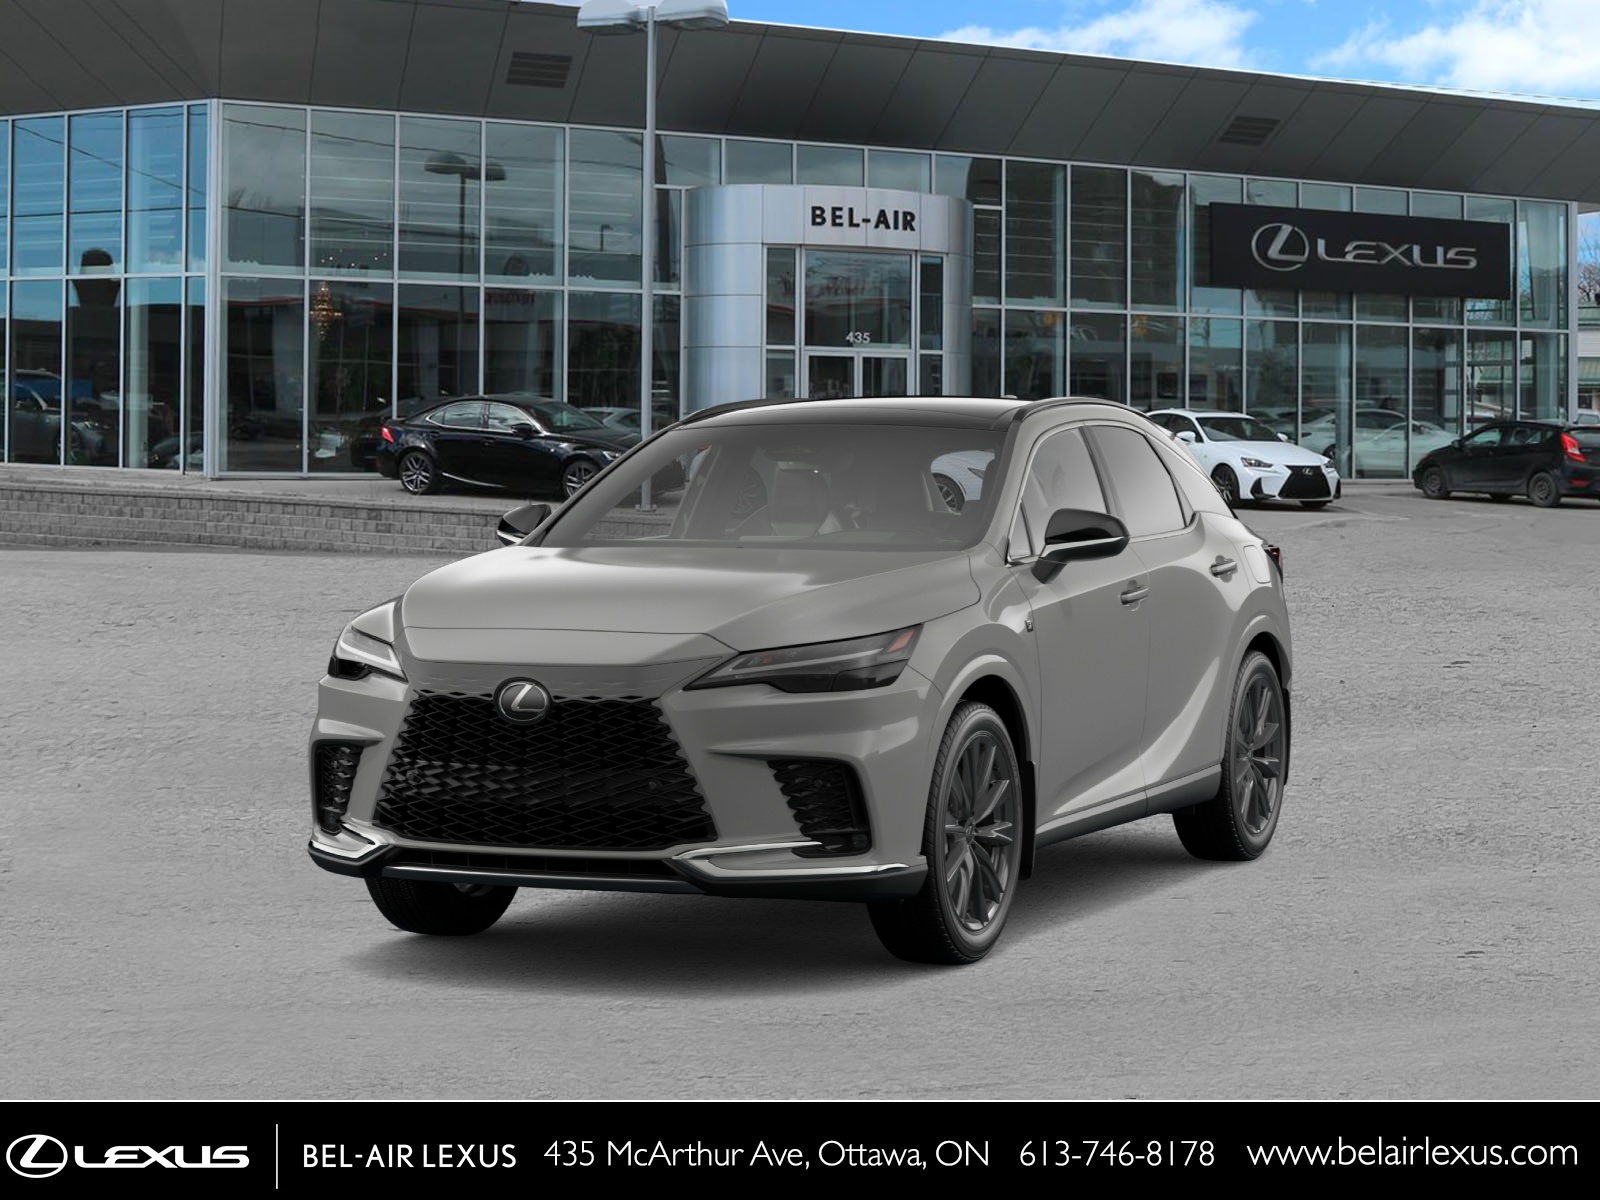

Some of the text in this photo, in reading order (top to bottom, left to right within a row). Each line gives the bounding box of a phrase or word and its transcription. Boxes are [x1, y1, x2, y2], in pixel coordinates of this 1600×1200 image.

[811, 205, 916, 232] BEL-AIR
[1317, 237, 1478, 270] LEXUS
[845, 331, 871, 344] 435
